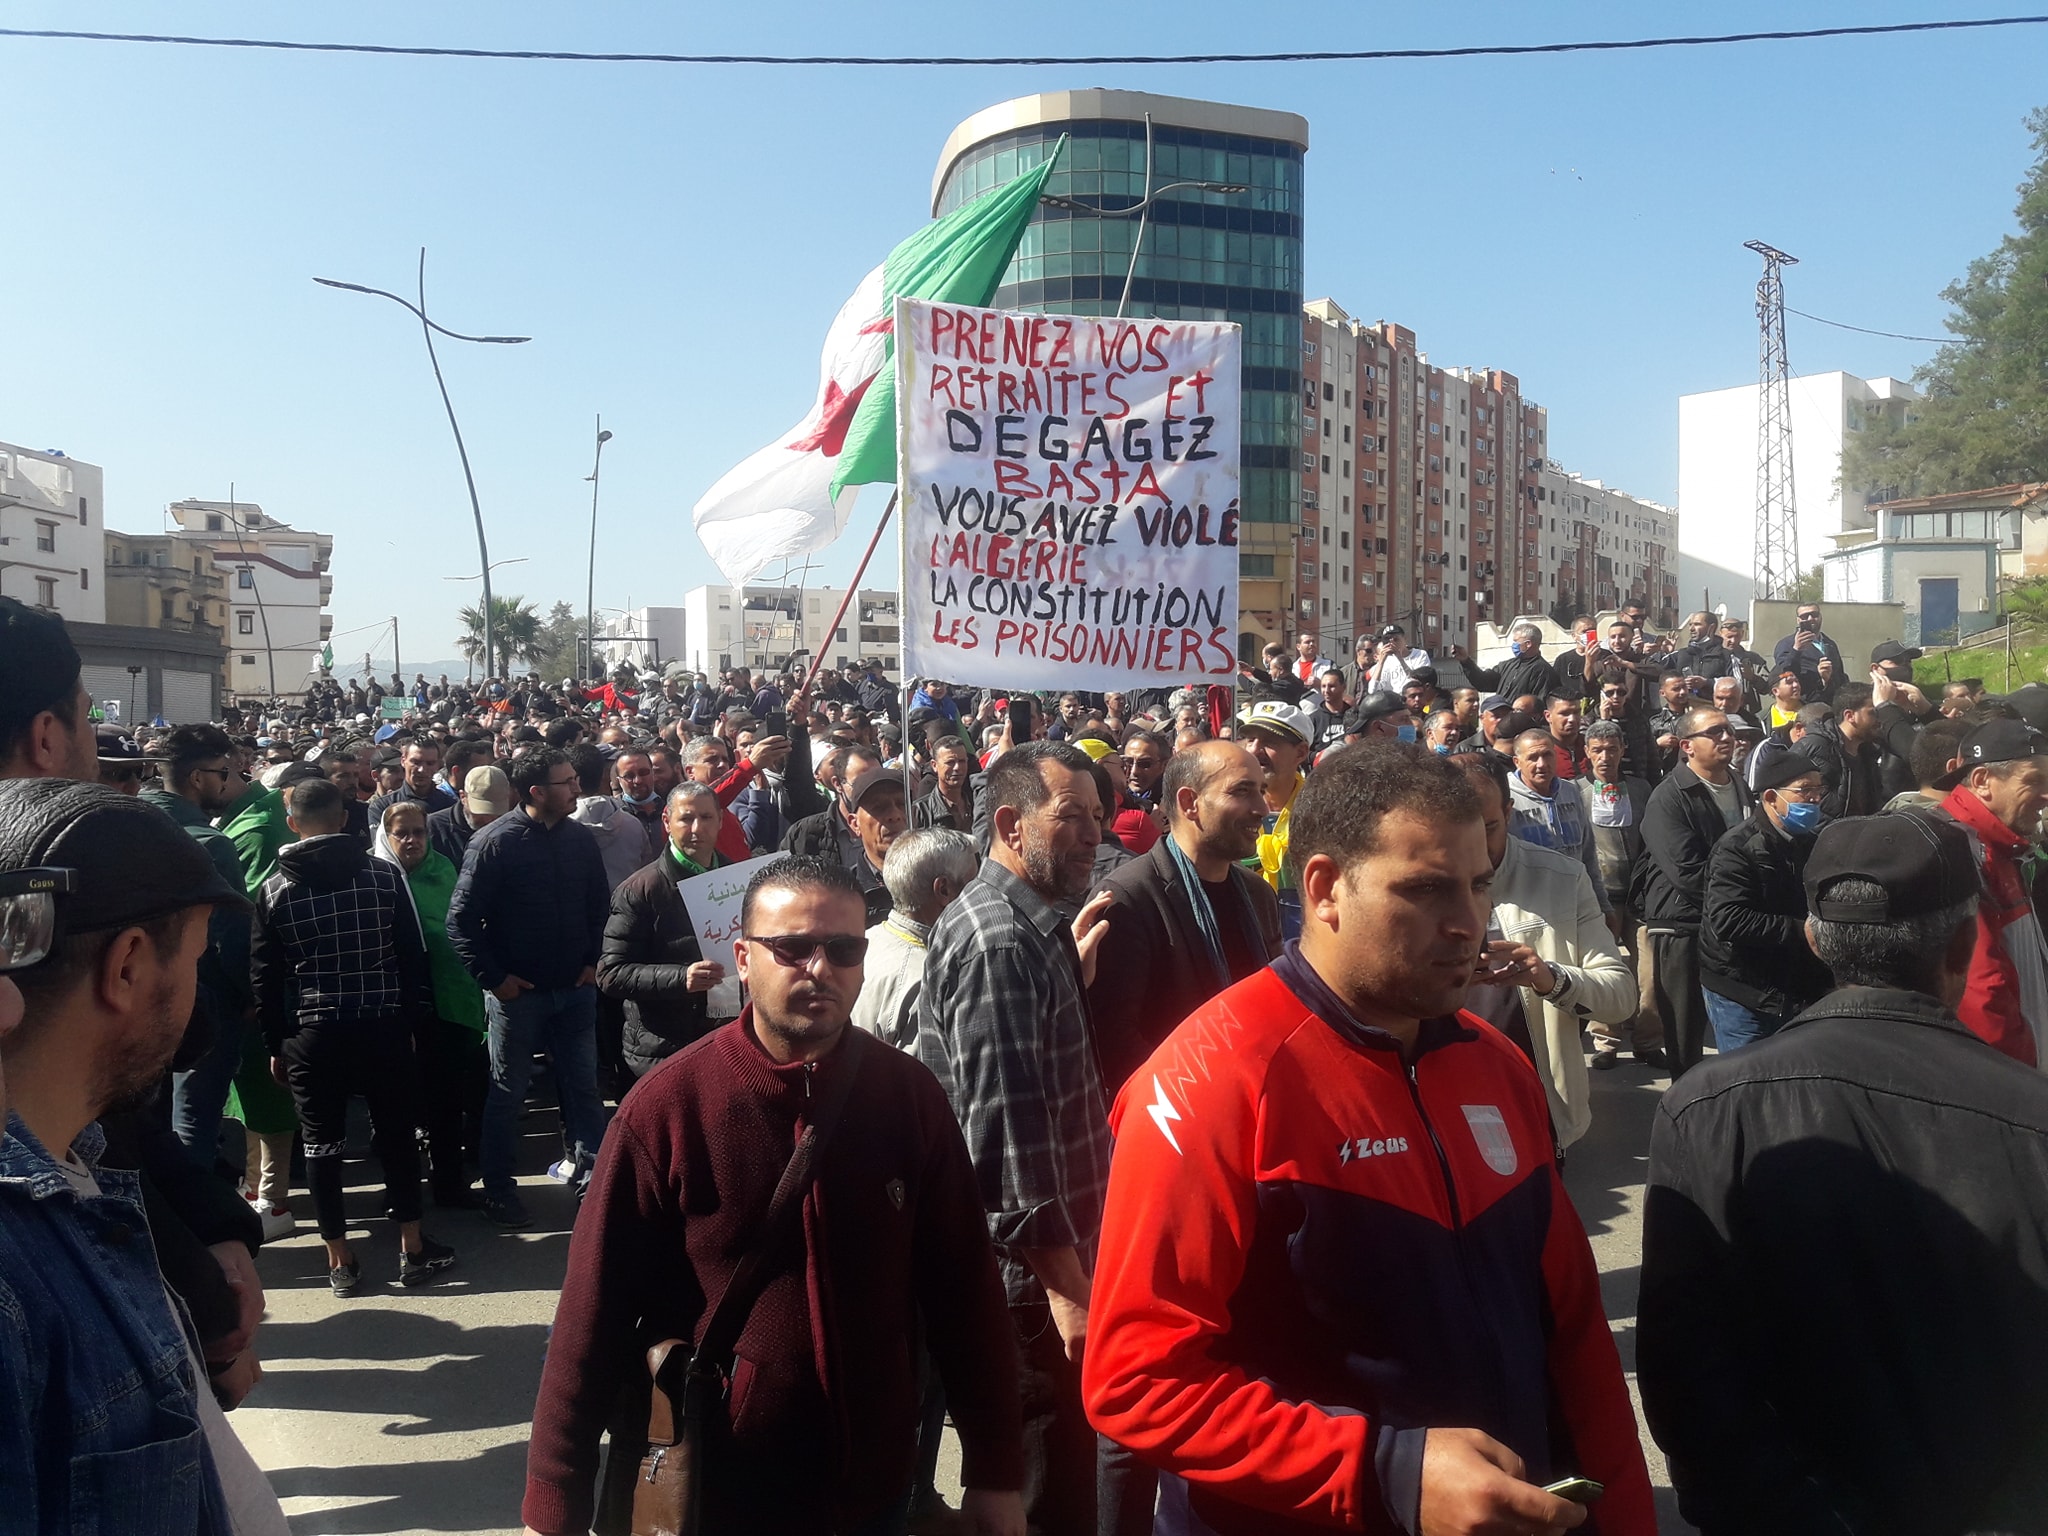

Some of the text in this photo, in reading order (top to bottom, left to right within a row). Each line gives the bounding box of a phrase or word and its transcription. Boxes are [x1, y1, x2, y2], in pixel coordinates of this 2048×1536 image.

[931, 307, 1170, 373] PRENEZ VOS
[994, 459, 1172, 505] BASTA
[931, 482, 1026, 536] VOUS
[1032, 502, 1118, 545] AVEZ
[930, 570, 959, 607] LA
[932, 610, 1236, 675] LES PRISONNIERS
[1973, 745, 1982, 758] 3
[29, 878, 55, 889] Gauss
[1356, 1137, 1408, 1159] Zeus
